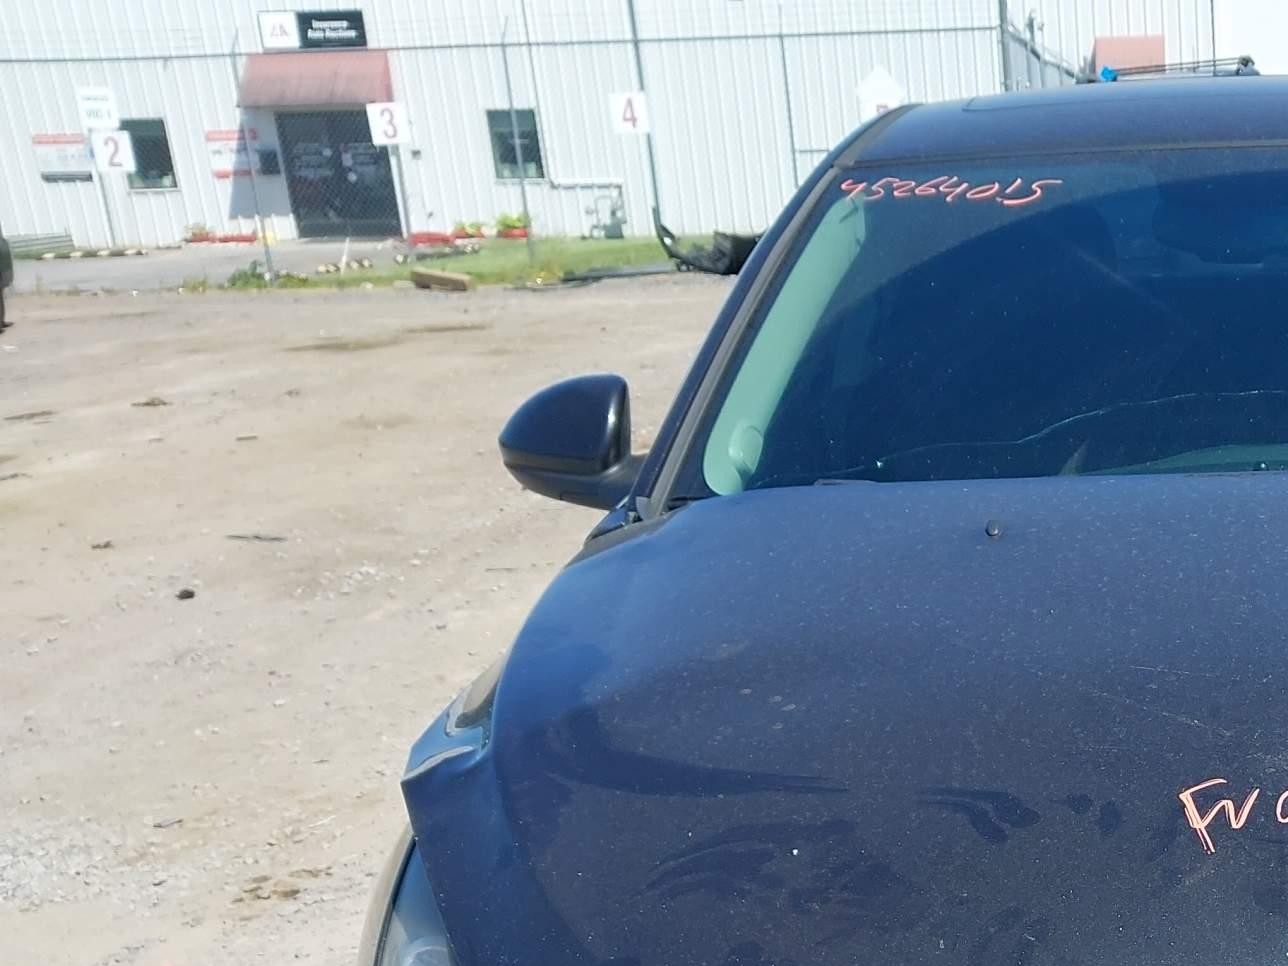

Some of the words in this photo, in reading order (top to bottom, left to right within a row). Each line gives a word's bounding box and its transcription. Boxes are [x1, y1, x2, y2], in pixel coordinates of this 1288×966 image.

[380, 108, 398, 139] 3
[622, 98, 638, 129] 4
[104, 136, 123, 167] 2
[841, 176, 1063, 204] 45264015
